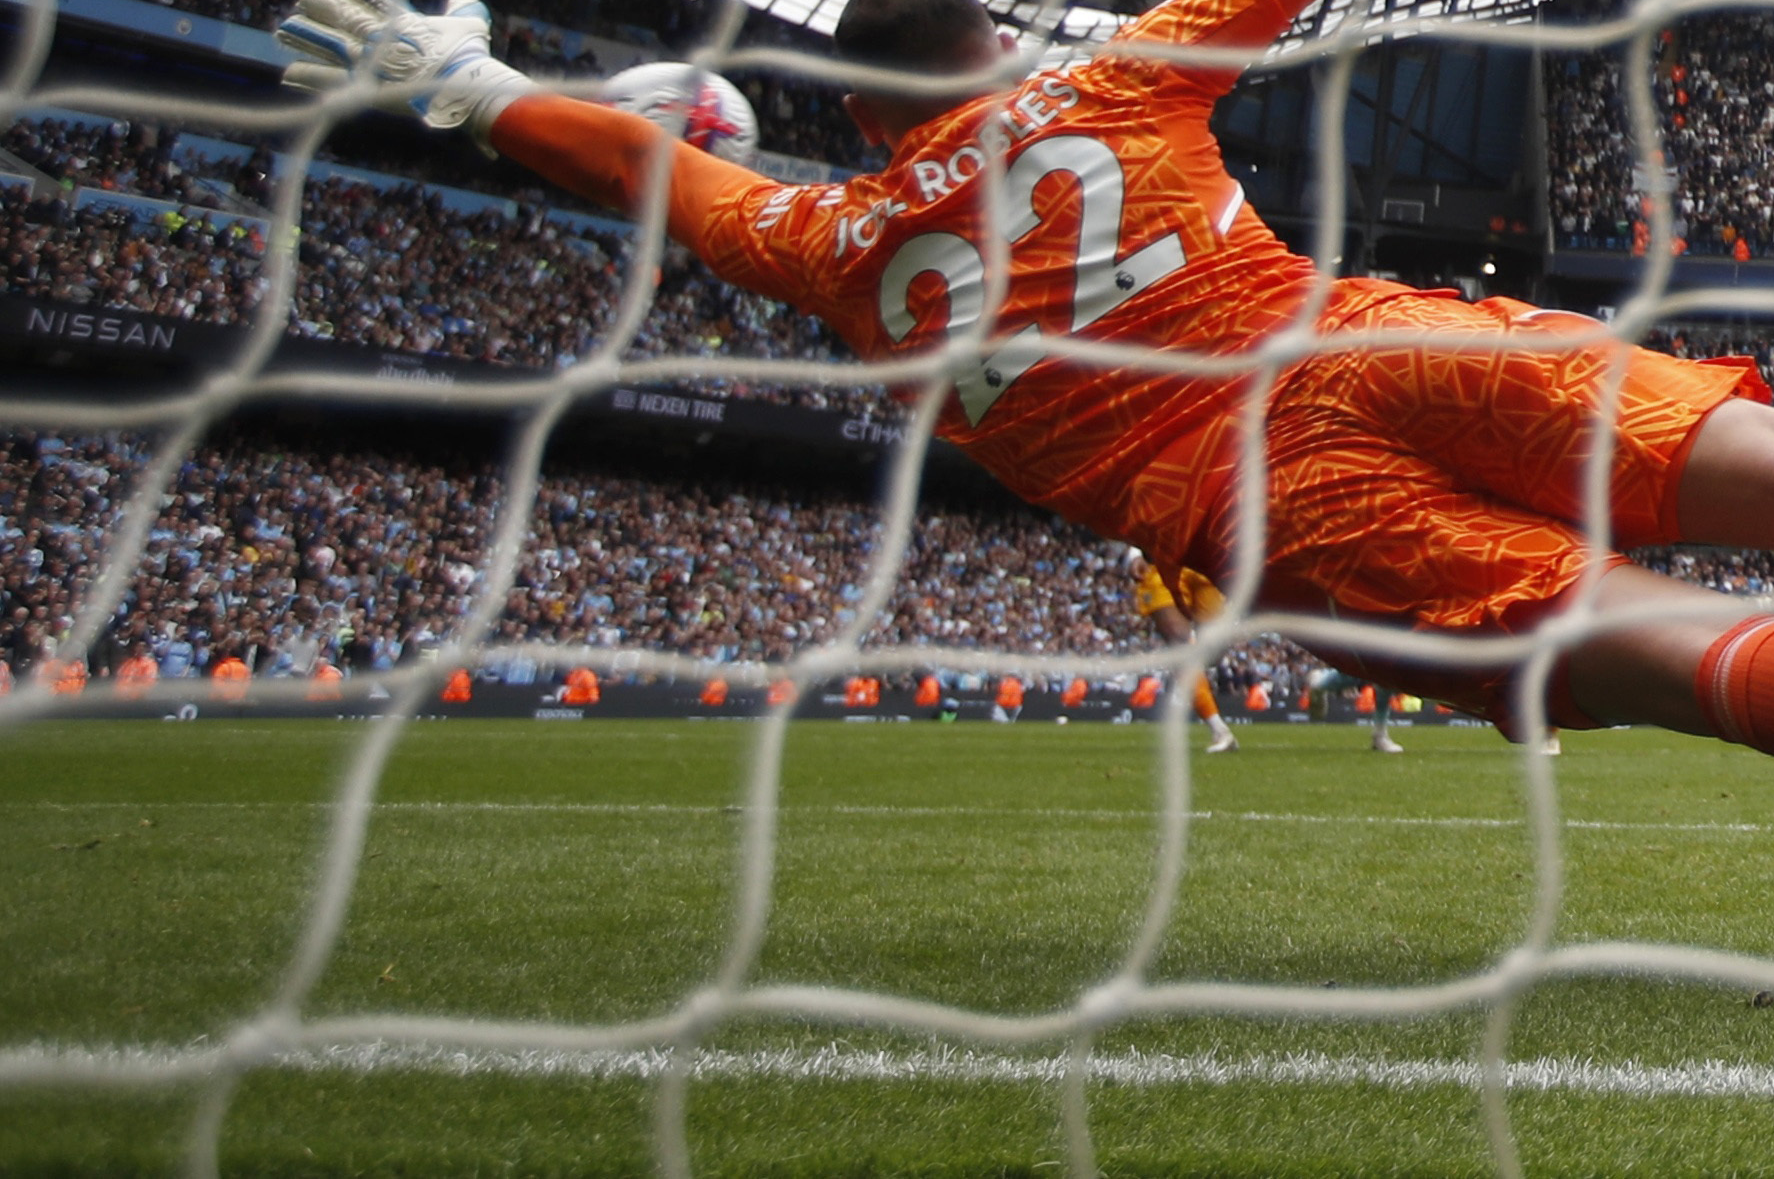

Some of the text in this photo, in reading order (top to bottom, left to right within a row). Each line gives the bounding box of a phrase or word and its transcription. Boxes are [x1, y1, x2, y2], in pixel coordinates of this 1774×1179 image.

[912, 77, 1080, 203] ROBLES
[880, 134, 1188, 429] 22
[28, 307, 177, 349] NISSAN
[639, 392, 727, 422] NEXEN TIRE
